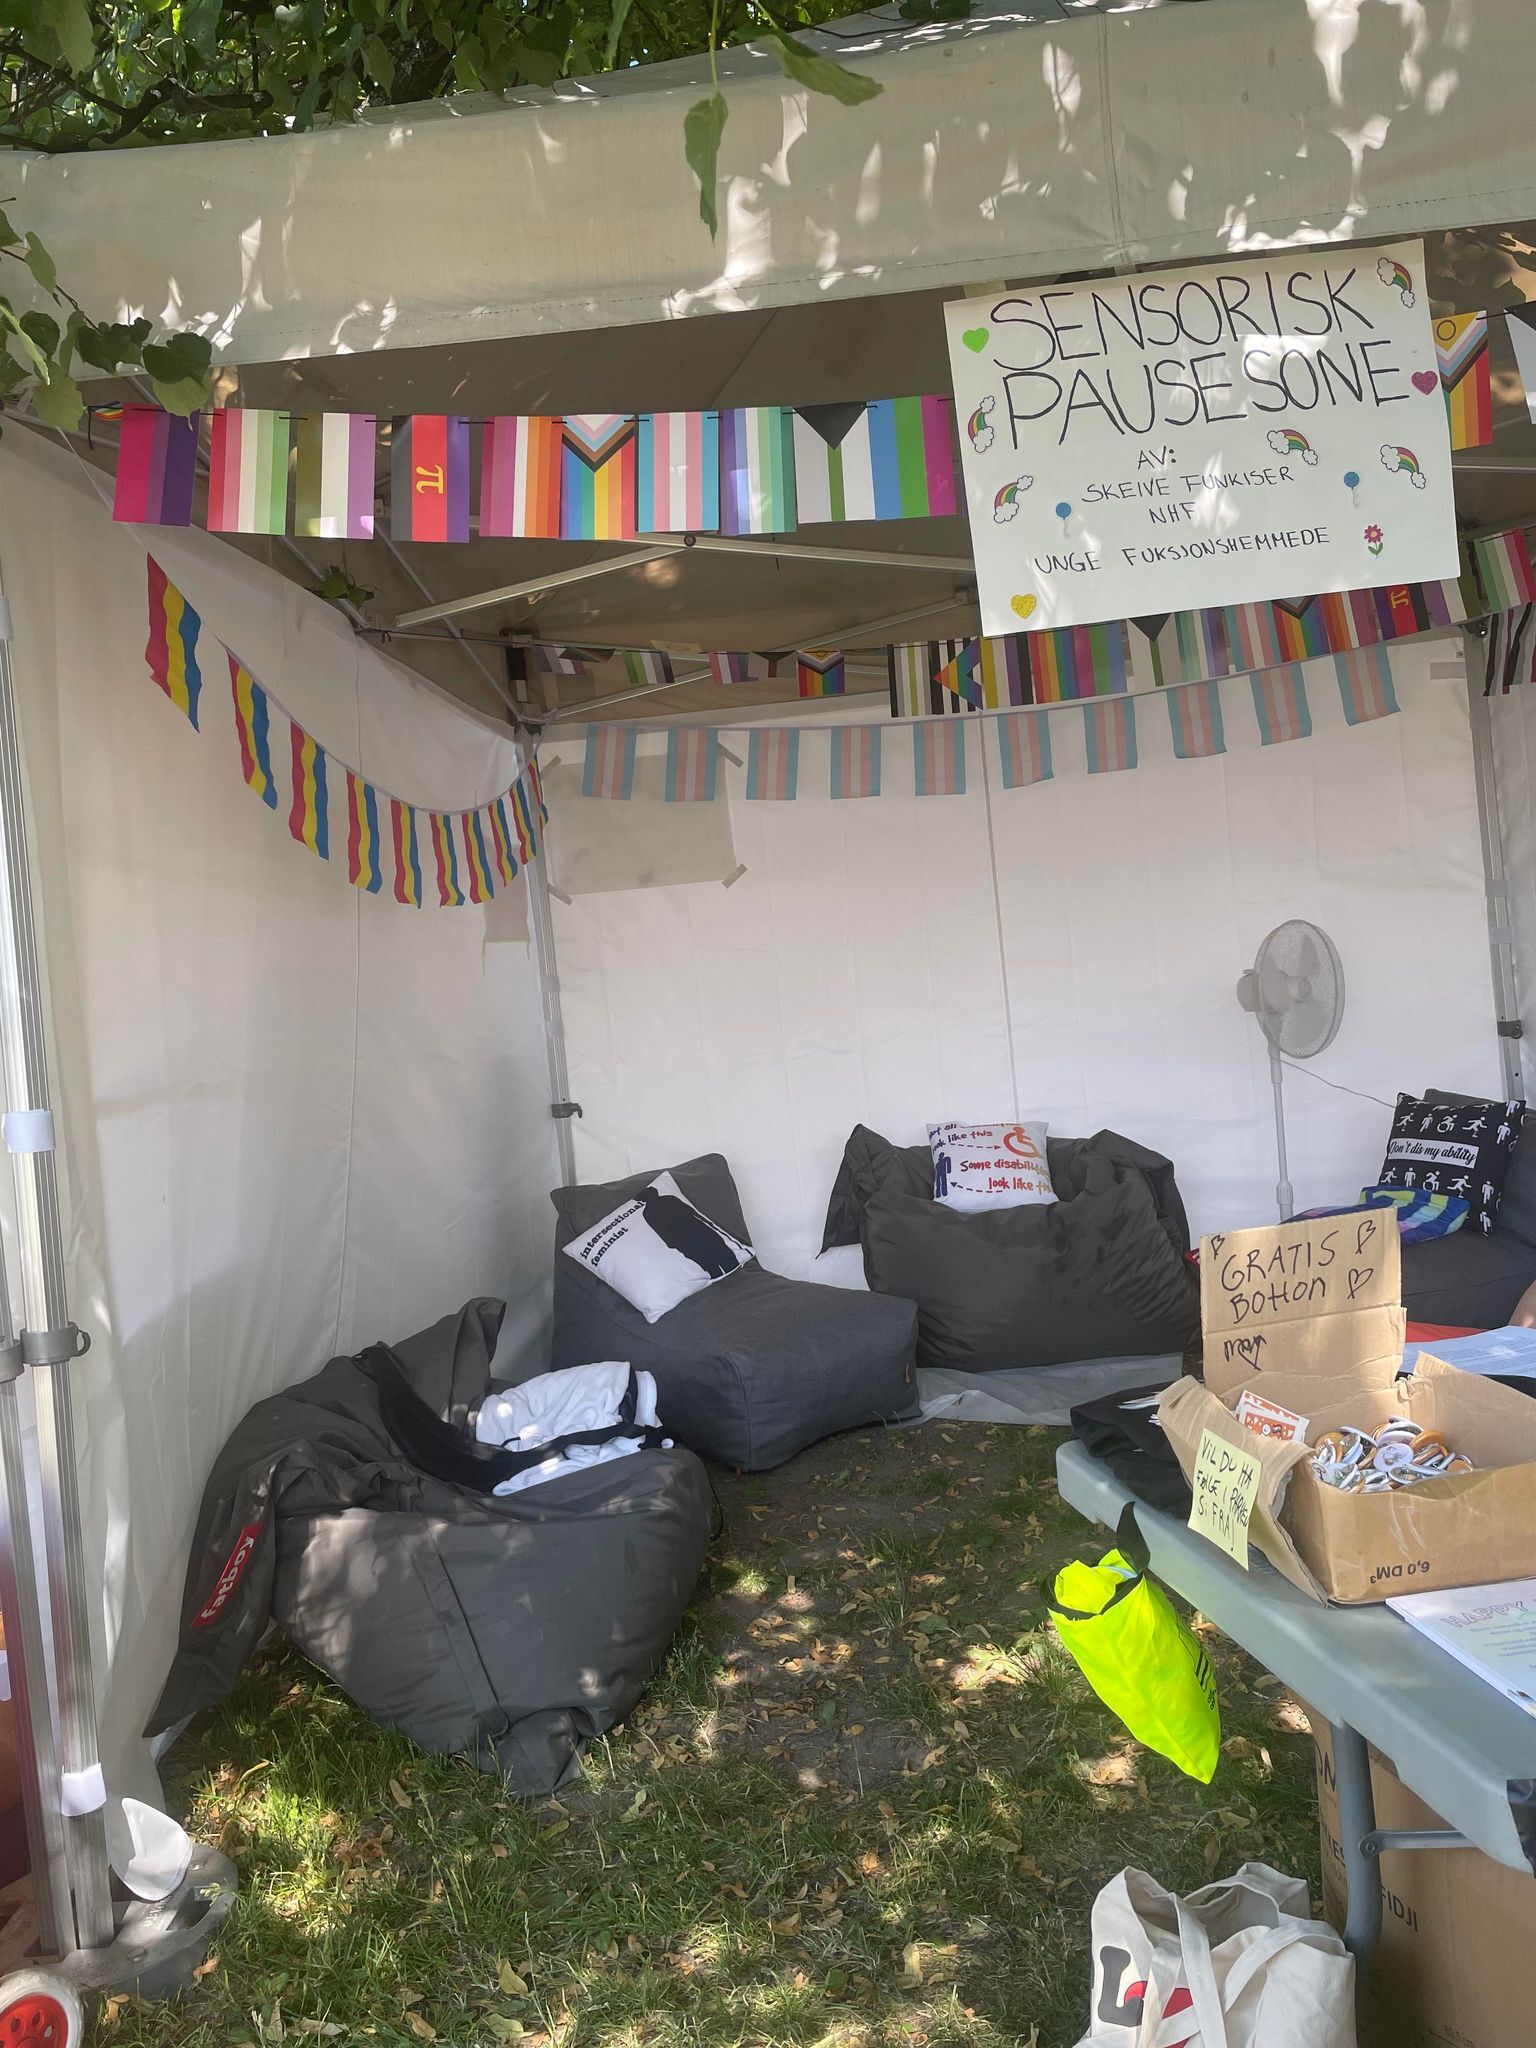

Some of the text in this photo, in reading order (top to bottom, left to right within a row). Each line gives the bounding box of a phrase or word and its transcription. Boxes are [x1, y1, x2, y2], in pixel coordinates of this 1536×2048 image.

[990, 268, 1374, 371] SENSORISK
[1138, 446, 1177, 470] AV:
[1082, 466, 1295, 502] SKEIVE FUNKISER
[1149, 502, 1197, 523] NHF
[1035, 551, 1102, 574] UNGE
[960, 1160, 991, 1172] Some
[1424, 1146, 1440, 1160] my
[1441, 1145, 1475, 1165] ability
[988, 1177, 1010, 1190] look
[1013, 1177, 1034, 1190] like
[580, 1201, 646, 1260] intersectional
[591, 1227, 628, 1267] feminist
[1221, 1230, 1339, 1291] GRATIS
[1439, 1600, 1530, 1629] HAPPY
